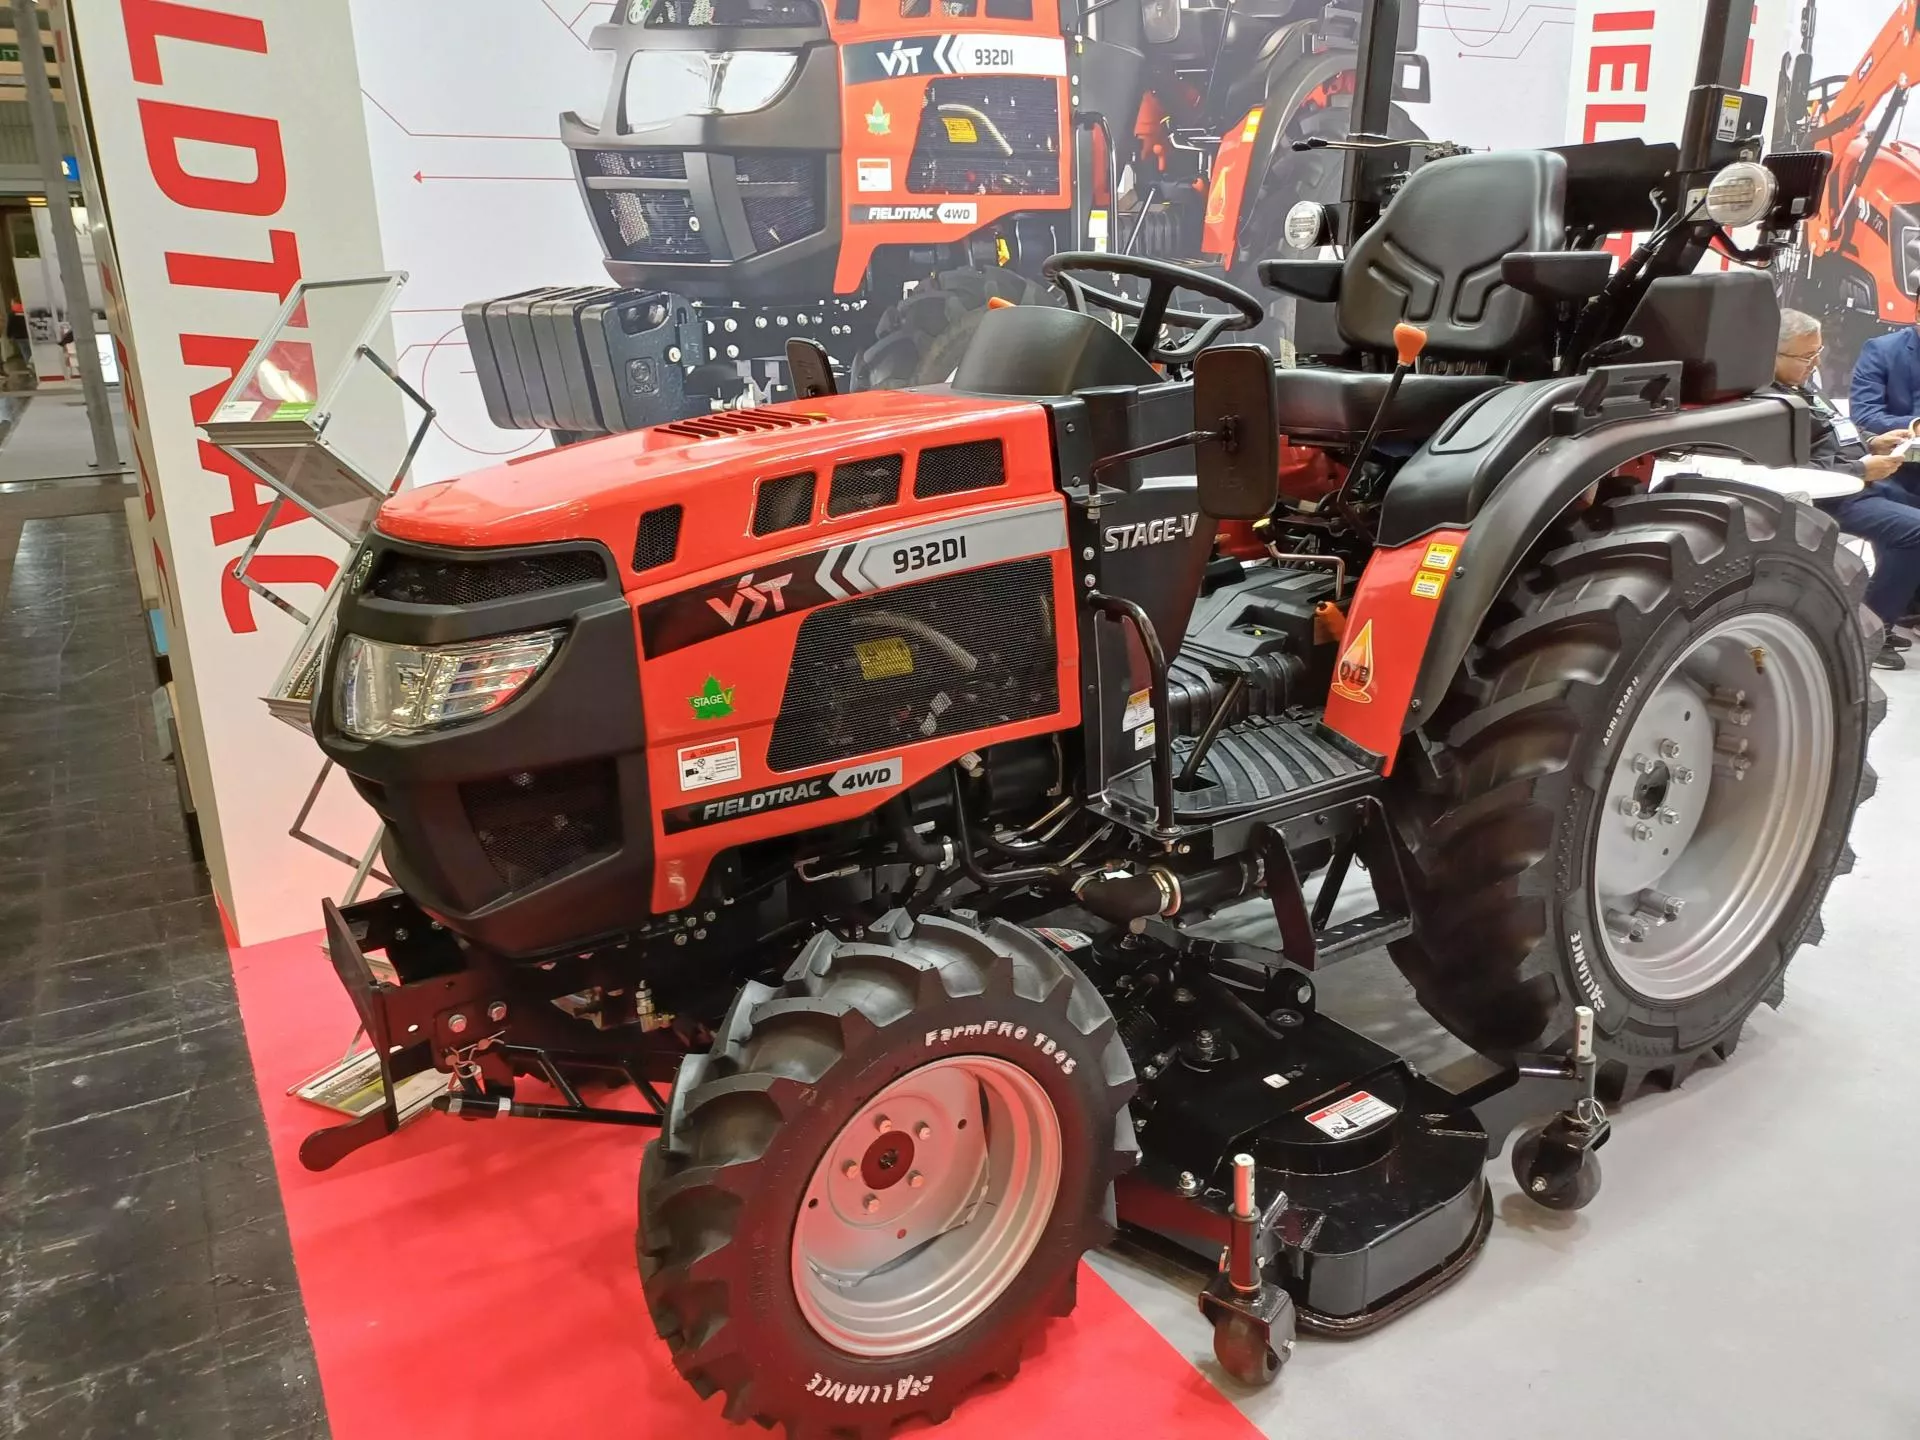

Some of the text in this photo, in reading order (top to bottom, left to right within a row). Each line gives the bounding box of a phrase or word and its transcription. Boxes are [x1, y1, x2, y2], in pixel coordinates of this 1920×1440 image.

[876, 40, 923, 77] VST
[975, 48, 1013, 66] 932DI
[868, 207, 970, 220] FIELDTRAC 4WD
[1102, 512, 1199, 554] STAGE-V
[893, 534, 967, 575] 932DI
[705, 573, 793, 627] VST
[1602, 715, 1619, 745] AGRI
[1615, 686, 1634, 716] STAR
[703, 766, 892, 821] FIELDTRAC 4WD
[1569, 930, 1603, 1003] ALLIANCE
[804, 1372, 914, 1404] ALLIANCE
